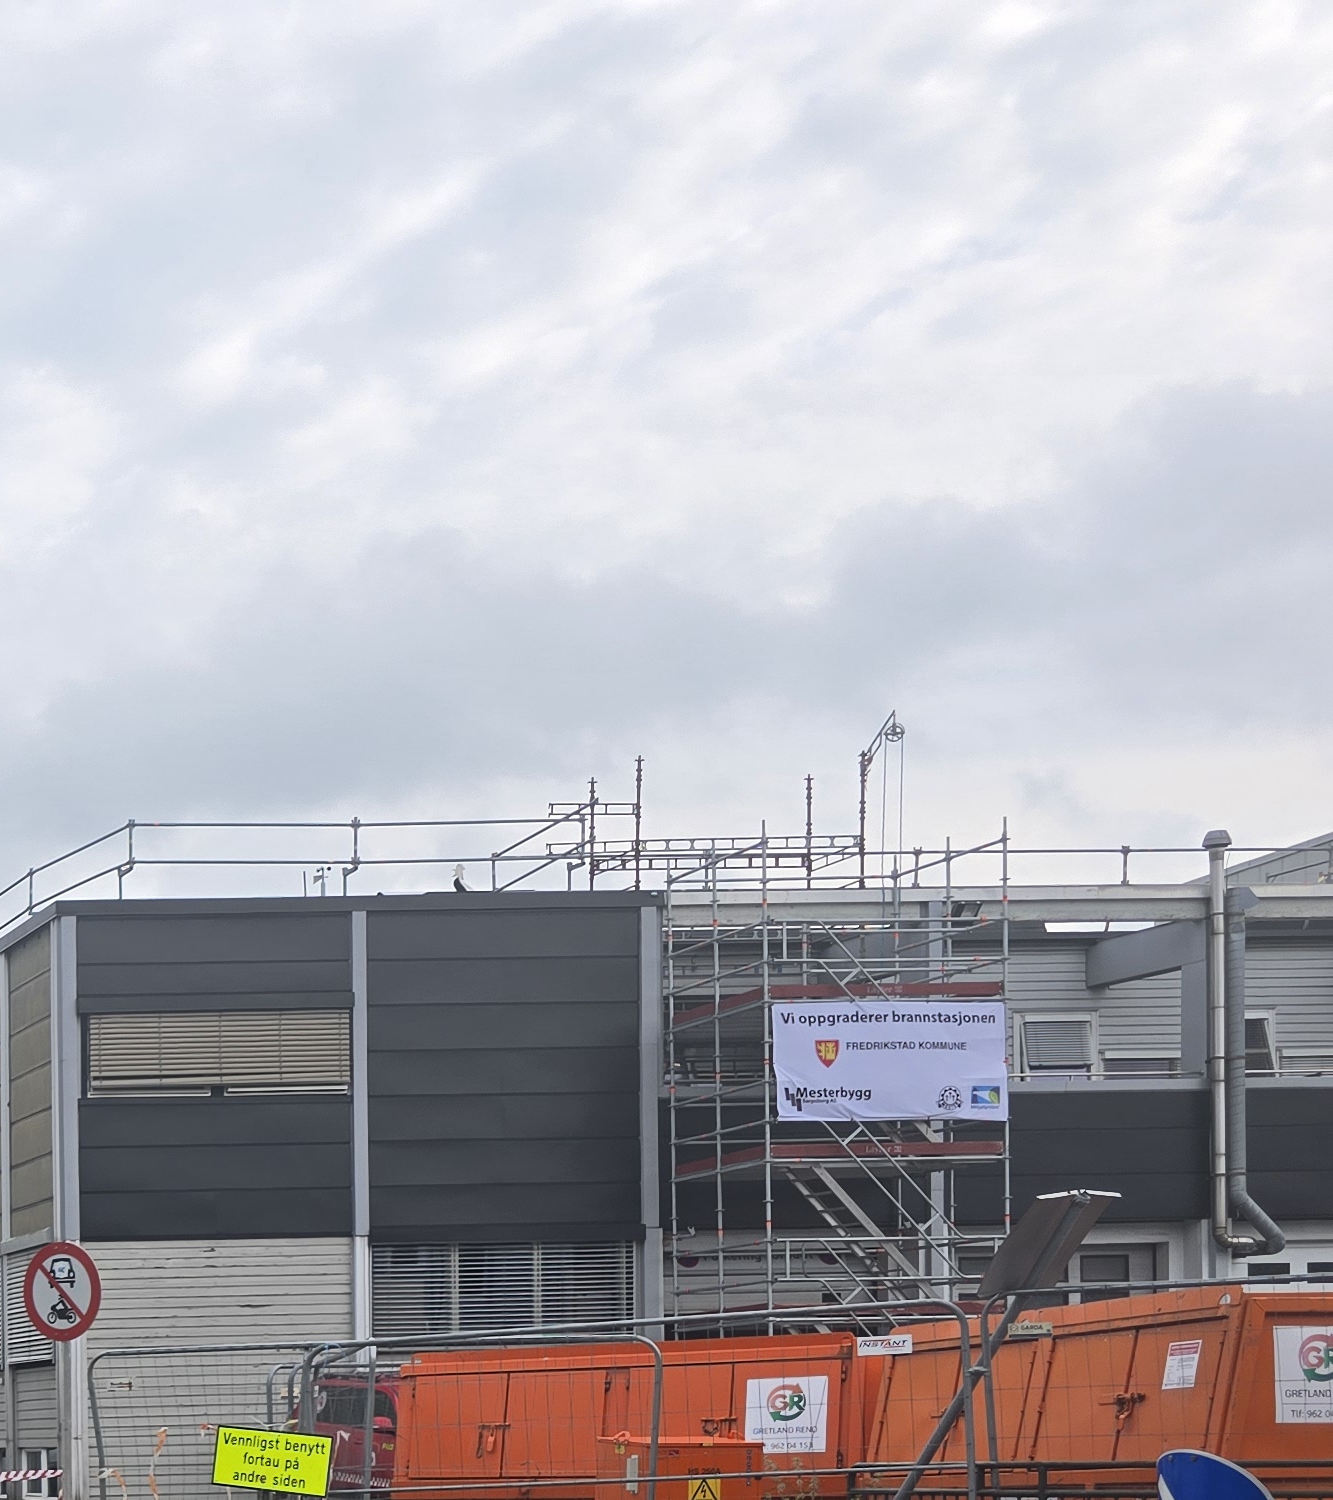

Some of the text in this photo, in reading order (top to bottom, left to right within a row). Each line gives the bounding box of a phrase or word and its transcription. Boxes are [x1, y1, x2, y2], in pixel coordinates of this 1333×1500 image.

[780, 1010, 996, 1027] Vi oppgraderer brannstasjonen
[846, 1041, 967, 1050] FREDRIKSTAD KOMMUNE
[796, 1086, 872, 1100] Mesterbygg
[859, 1339, 908, 1348] INSTANT
[1284, 1389, 1332, 1398] GRETLAND
[1306, 1409, 1323, 1418] 962
[753, 1427, 794, 1435] GRETLAND
[223, 1432, 326, 1457] Vennligst benytt
[243, 1451, 300, 1472] fortau på
[233, 1471, 306, 1489] andre siden
